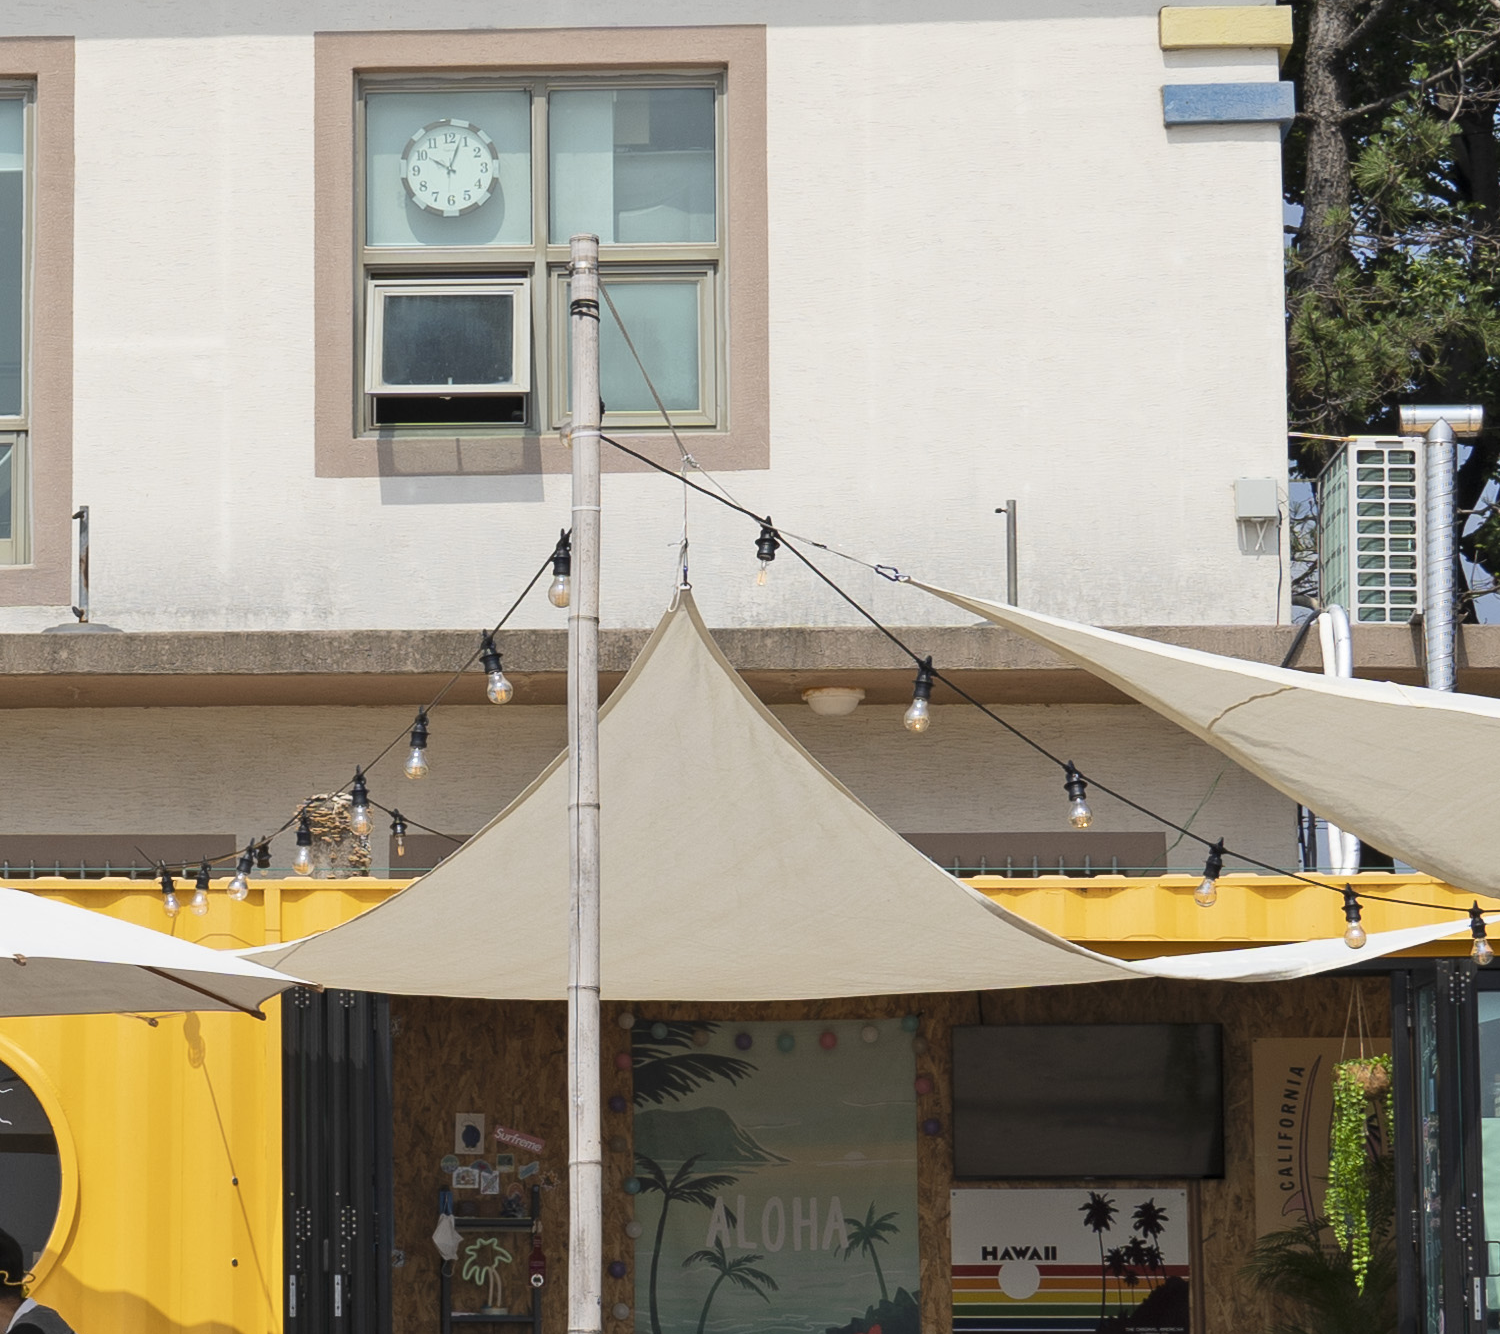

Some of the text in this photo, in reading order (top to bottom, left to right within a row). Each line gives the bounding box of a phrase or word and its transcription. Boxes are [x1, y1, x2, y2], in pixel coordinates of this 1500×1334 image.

[428, 137, 439, 149] 11
[443, 132, 456, 144] 12
[462, 136, 469, 148] 1
[415, 149, 428, 161] 10
[473, 147, 482, 158] 2
[412, 165, 421, 177] 9
[480, 162, 489, 174] 3
[419, 180, 428, 192] 8
[473, 178, 482, 190] 4
[431, 191, 440, 203] 7
[447, 194, 456, 206] 6
[463, 190, 472, 202] 5
[1277, 1065, 1306, 1192] CALIFORNIA
[494, 1127, 544, 1152] Surfreme
[704, 1193, 851, 1254] ALOHA
[980, 1244, 1058, 1262] HAWAII
